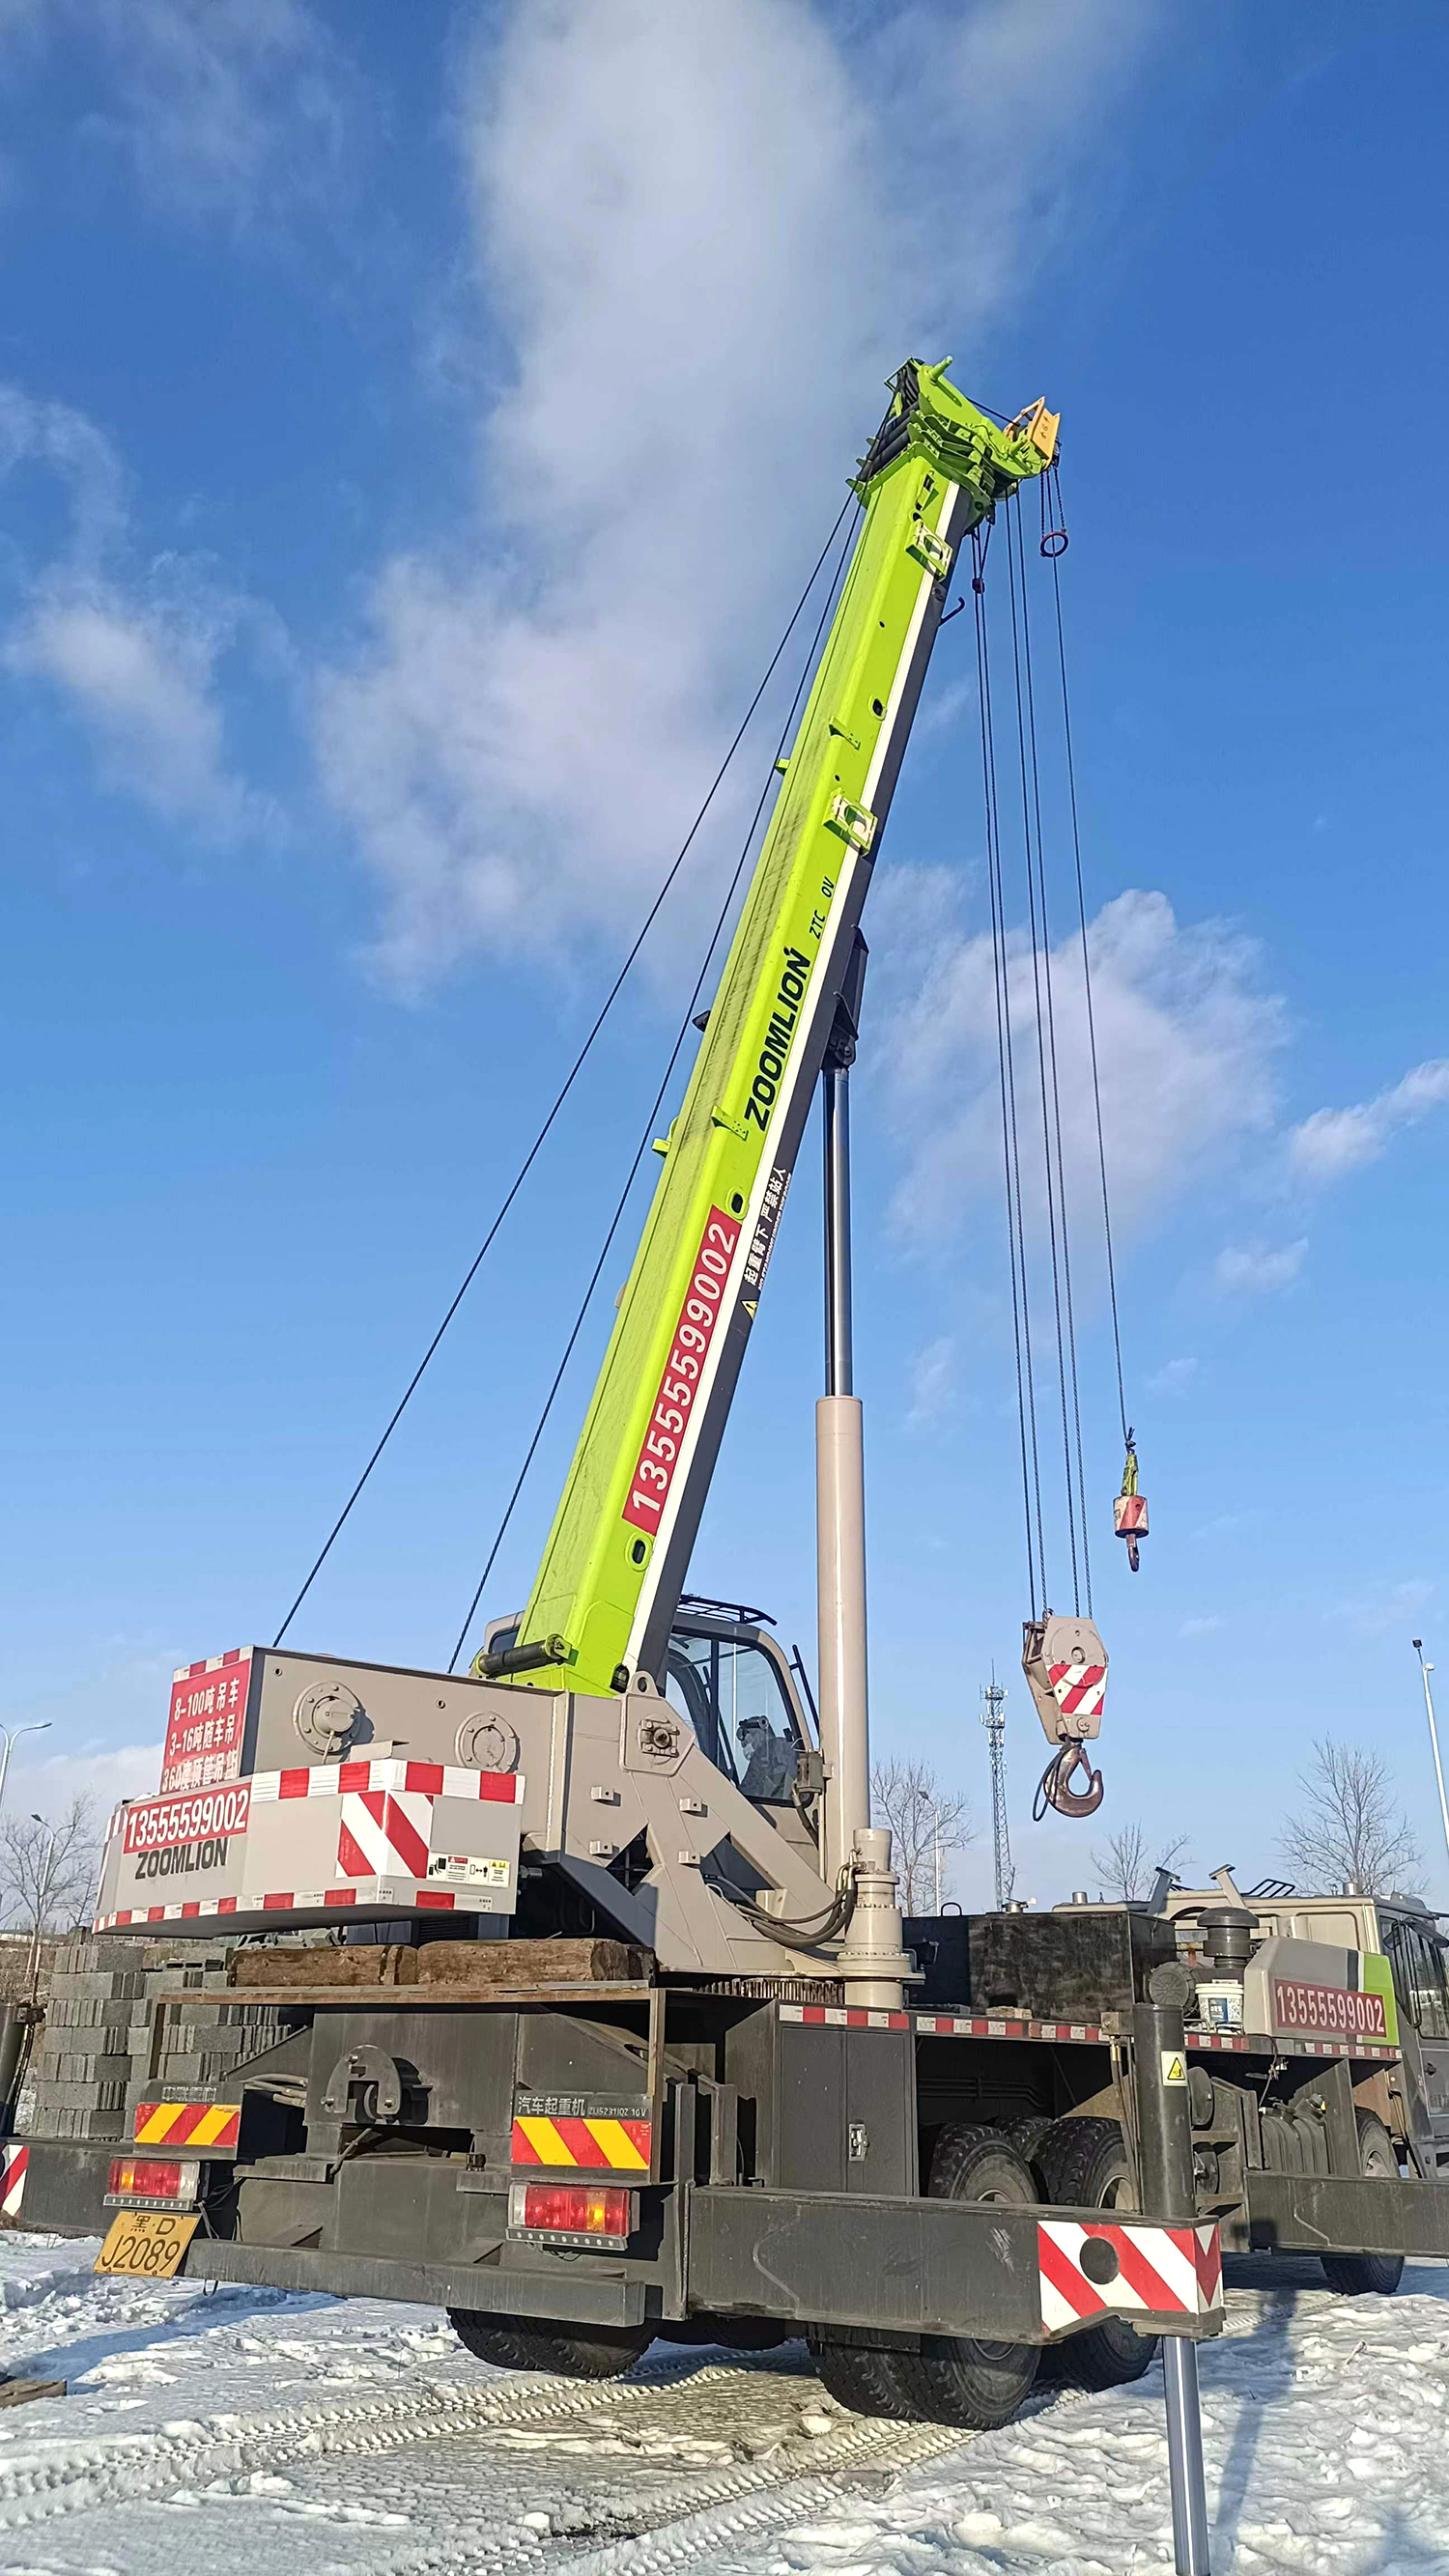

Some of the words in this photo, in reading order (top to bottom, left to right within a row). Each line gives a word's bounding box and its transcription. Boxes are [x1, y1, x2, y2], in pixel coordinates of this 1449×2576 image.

[810, 910, 826, 940] ZTC
[744, 947, 811, 1131] ZOOMLION
[743, 1223, 769, 1286] 起重臂下
[760, 1167, 786, 1223] 严禁站人
[631, 1223, 735, 1512] 13555599002
[128, 1789, 249, 1849] 13555599002
[135, 1837, 229, 1880] ZOOMLION
[1277, 1985, 1384, 2033] 13555599002
[518, 2096, 585, 2116] 汽车起重机
[631, 2108, 647, 2117] 10V
[101, 2234, 181, 2272] J2089
